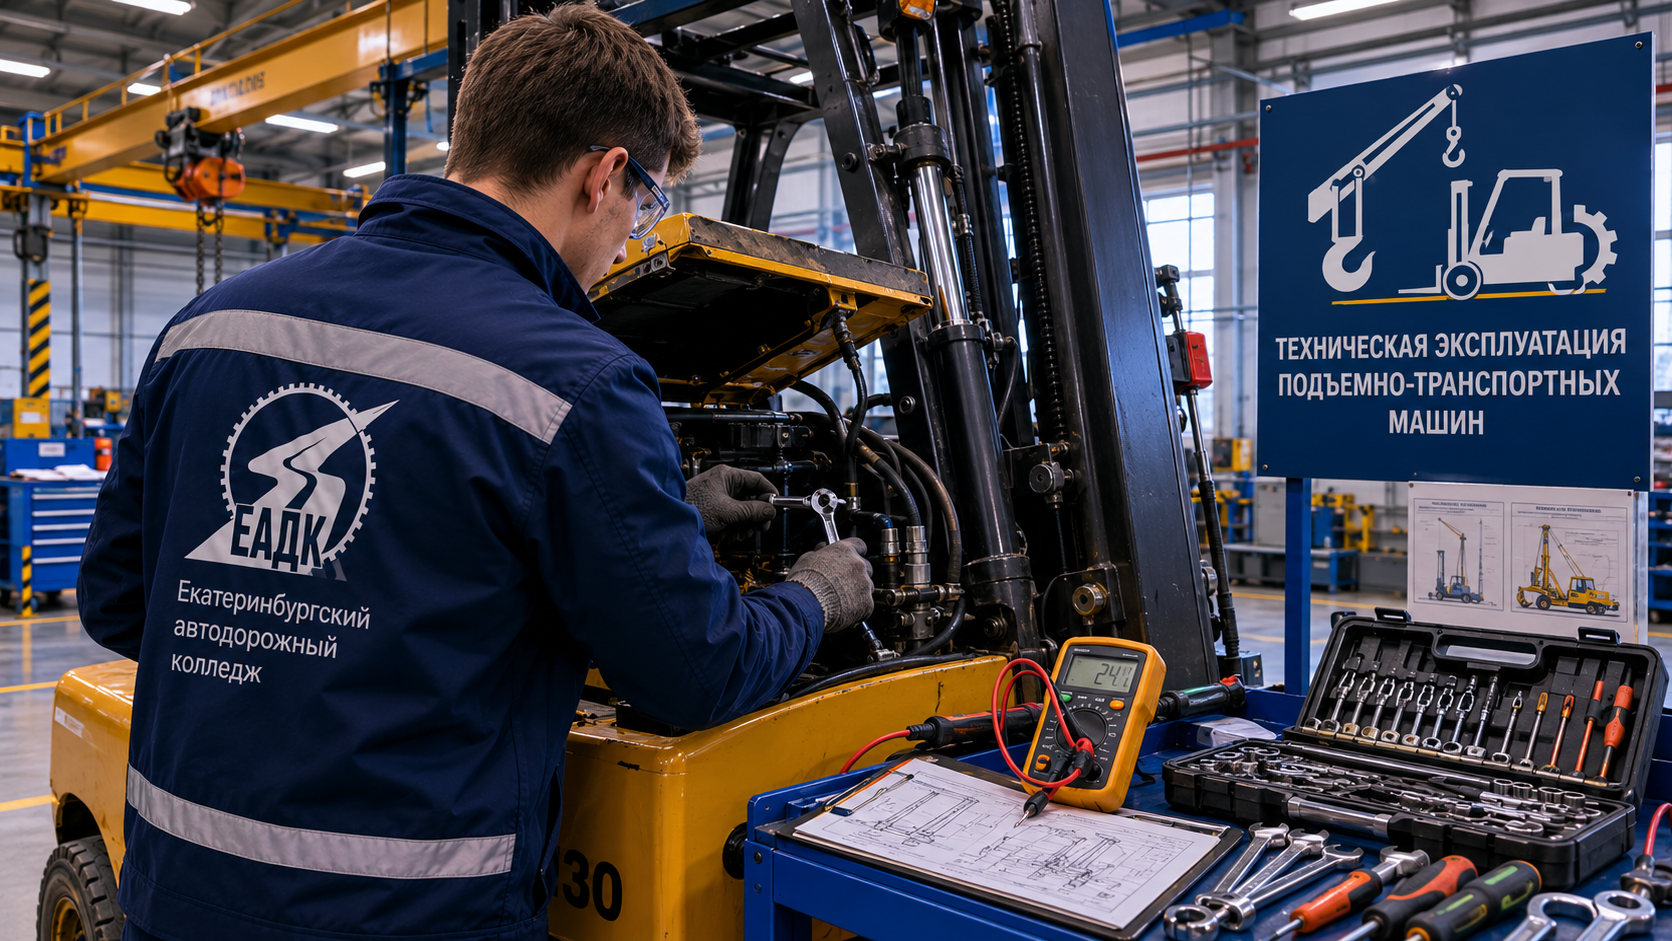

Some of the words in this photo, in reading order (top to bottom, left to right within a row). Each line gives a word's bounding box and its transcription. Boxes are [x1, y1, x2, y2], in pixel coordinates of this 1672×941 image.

[1275, 333, 1428, 361] ТЕХНИЧЕСКАЯ
[1434, 328, 1627, 360] ЭКСПЛУАТАЦИЯ
[1278, 368, 1621, 400] ПОДЪЕМНО-ТРАНСПОРТНЫХ
[1388, 409, 1485, 435] МАШИН
[230, 502, 327, 573] ЕАДК
[176, 579, 371, 630] Екатеринбургский
[173, 618, 338, 659] автодорожный
[171, 653, 263, 685] колледж
[553, 844, 623, 922] 30
